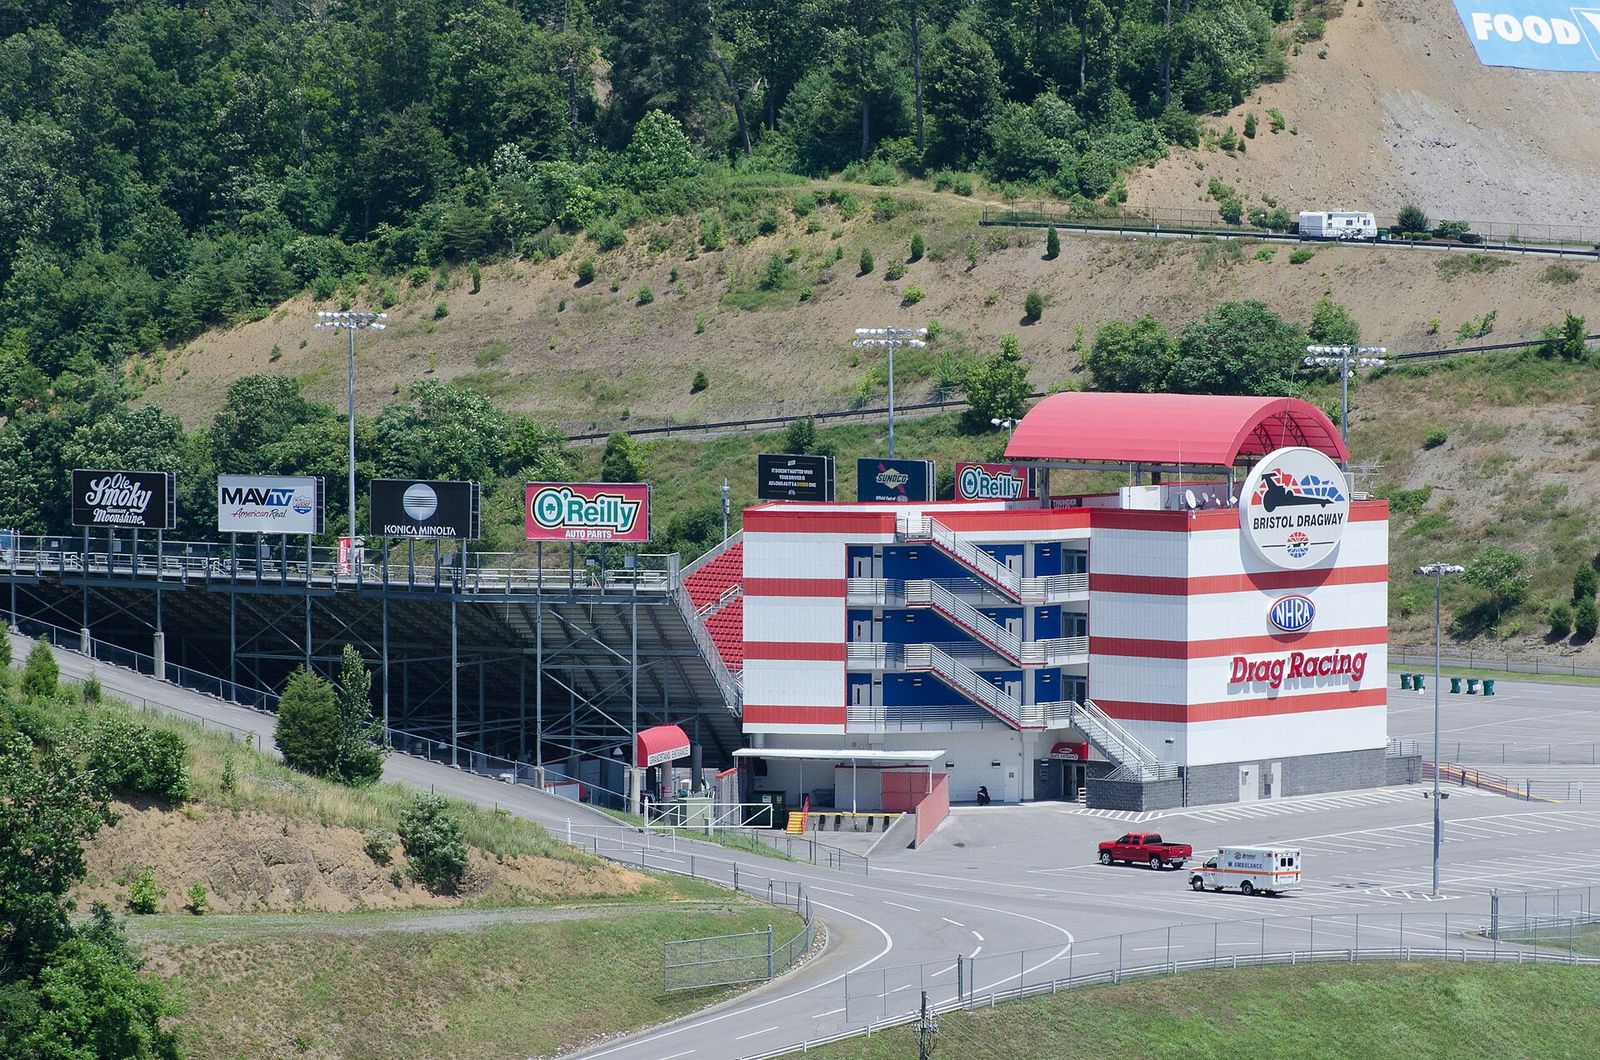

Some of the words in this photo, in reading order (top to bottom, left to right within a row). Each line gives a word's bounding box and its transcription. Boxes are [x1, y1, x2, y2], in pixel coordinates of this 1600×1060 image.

[1471, 12, 1580, 44] FOOD
[111, 473, 132, 490] Ole
[877, 474, 907, 483] SUNOCO
[961, 468, 1022, 499] O'Reilly
[85, 477, 152, 513] Smoky
[93, 508, 145, 526] Moonshine
[231, 507, 269, 518] American
[268, 508, 288, 519] Real
[535, 489, 636, 529] O'Reilly
[384, 525, 417, 534] KONICA
[418, 526, 456, 535] MINOLTA
[1253, 516, 1294, 530] BRISTOL
[1297, 513, 1343, 527] DRAGWAY
[565, 530, 585, 539] AUTO
[586, 530, 612, 539] PARTS
[1276, 600, 1310, 628] NHRA
[1231, 657, 1285, 689] Drag
[1287, 649, 1367, 681] Racing
